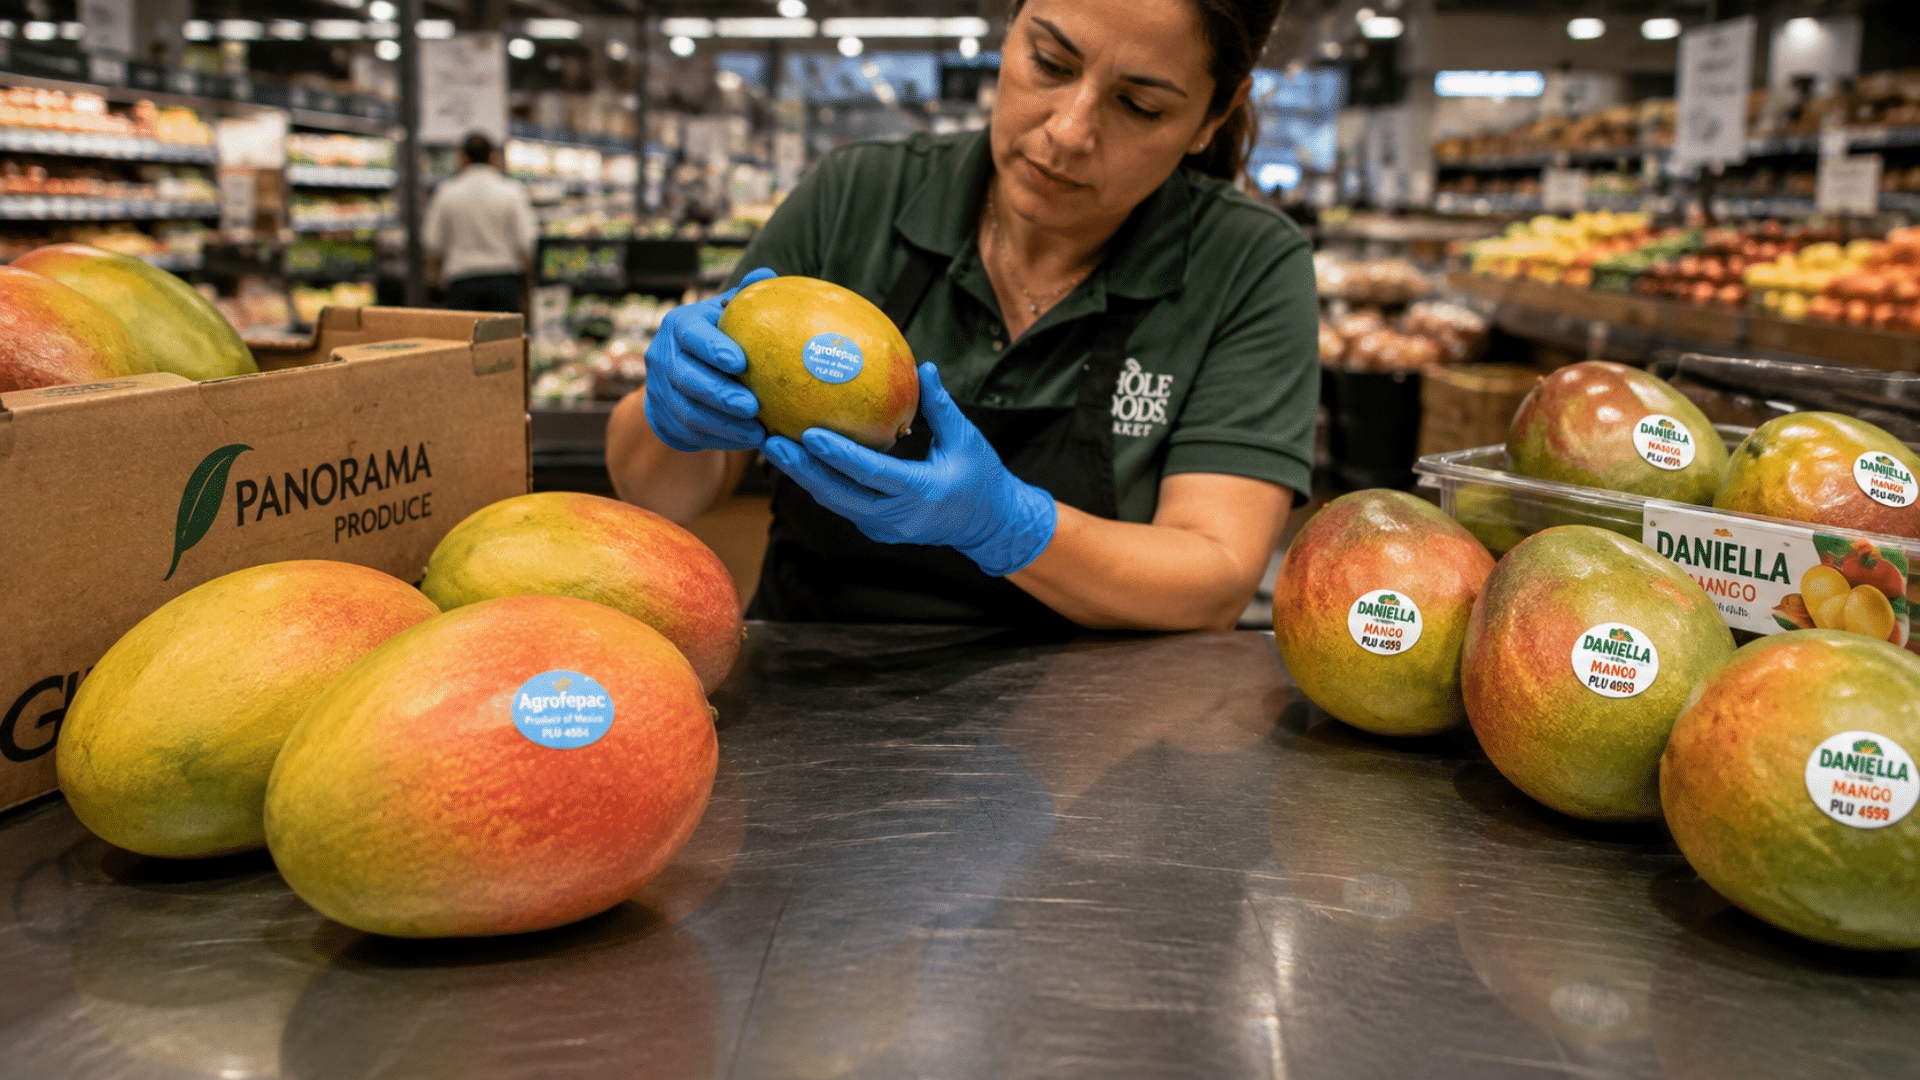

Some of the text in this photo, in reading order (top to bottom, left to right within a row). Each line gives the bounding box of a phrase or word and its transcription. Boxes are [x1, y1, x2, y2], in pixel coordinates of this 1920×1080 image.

[808, 341, 861, 364] Agrofepac
[1640, 422, 1690, 445] DANIELLA
[236, 442, 433, 528] PANORAMA
[334, 492, 433, 543] PRODUCE
[1657, 530, 1792, 585] DANIELLA
[1357, 601, 1416, 623] DANIELLA
[1361, 636, 1378, 648] PLU
[1583, 634, 1651, 664] DANIELLA
[1588, 675, 1609, 690] PLU
[519, 691, 606, 714] Agrofepac
[1819, 748, 1910, 782] DANIELLA
[1832, 779, 1893, 803] MANGO
[1830, 799, 1855, 816] PLU
